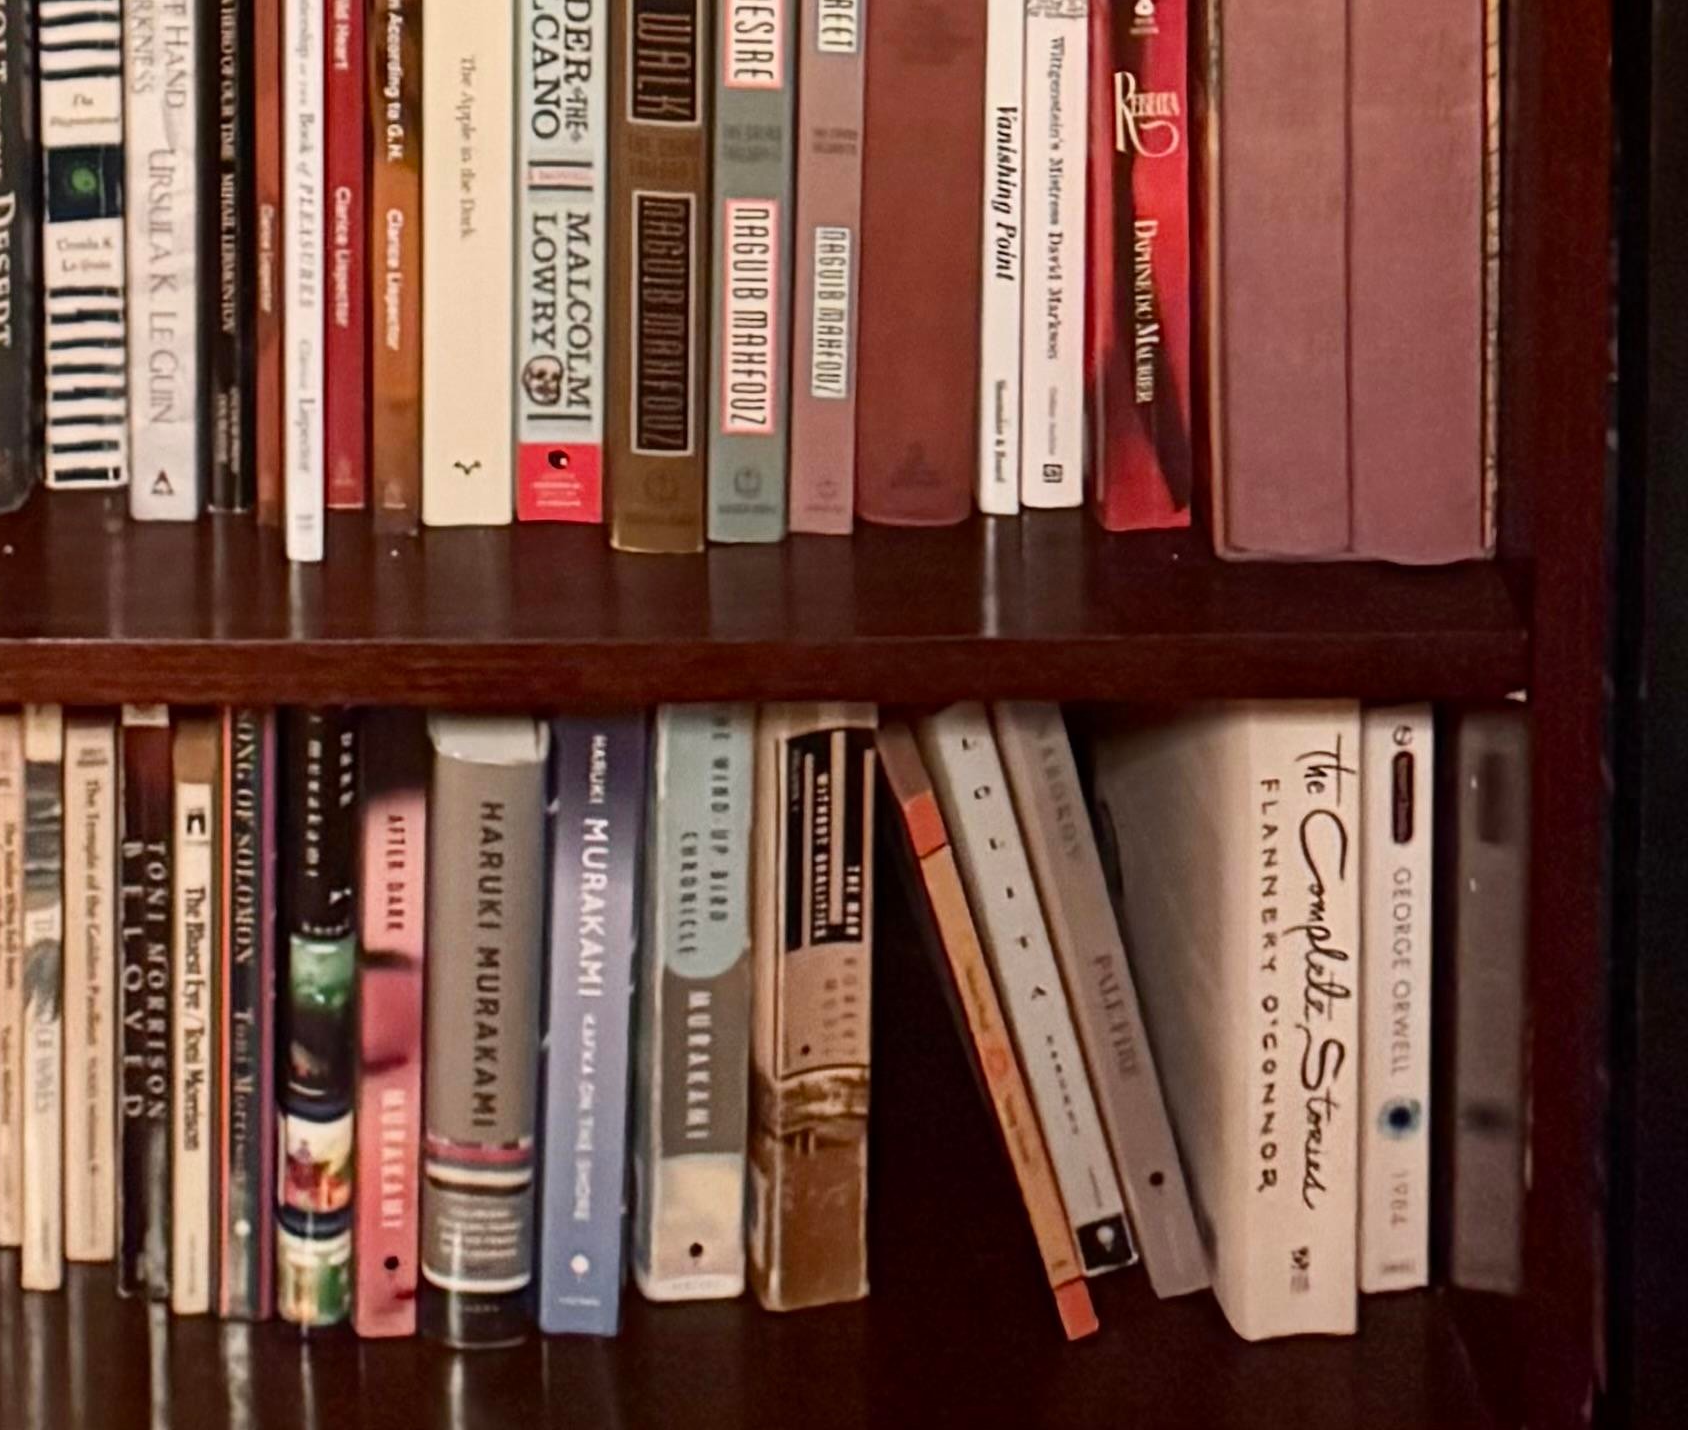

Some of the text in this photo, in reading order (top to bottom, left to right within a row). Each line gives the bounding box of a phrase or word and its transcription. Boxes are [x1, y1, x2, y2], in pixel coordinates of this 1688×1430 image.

[529, 213, 558, 351] LOWRY
[995, 106, 1020, 281] Vanishing Point
[564, 212, 592, 410] MALCOLM
[731, 207, 769, 426] NAGUIB MAHFOUZ
[472, 801, 504, 1128] HARUKI MURAKAMI
[577, 819, 609, 998] MURAKAMI
[1258, 778, 1280, 1193] FLANNERY O'CONNOR
[1282, 731, 1355, 1209] The Complete Stories
